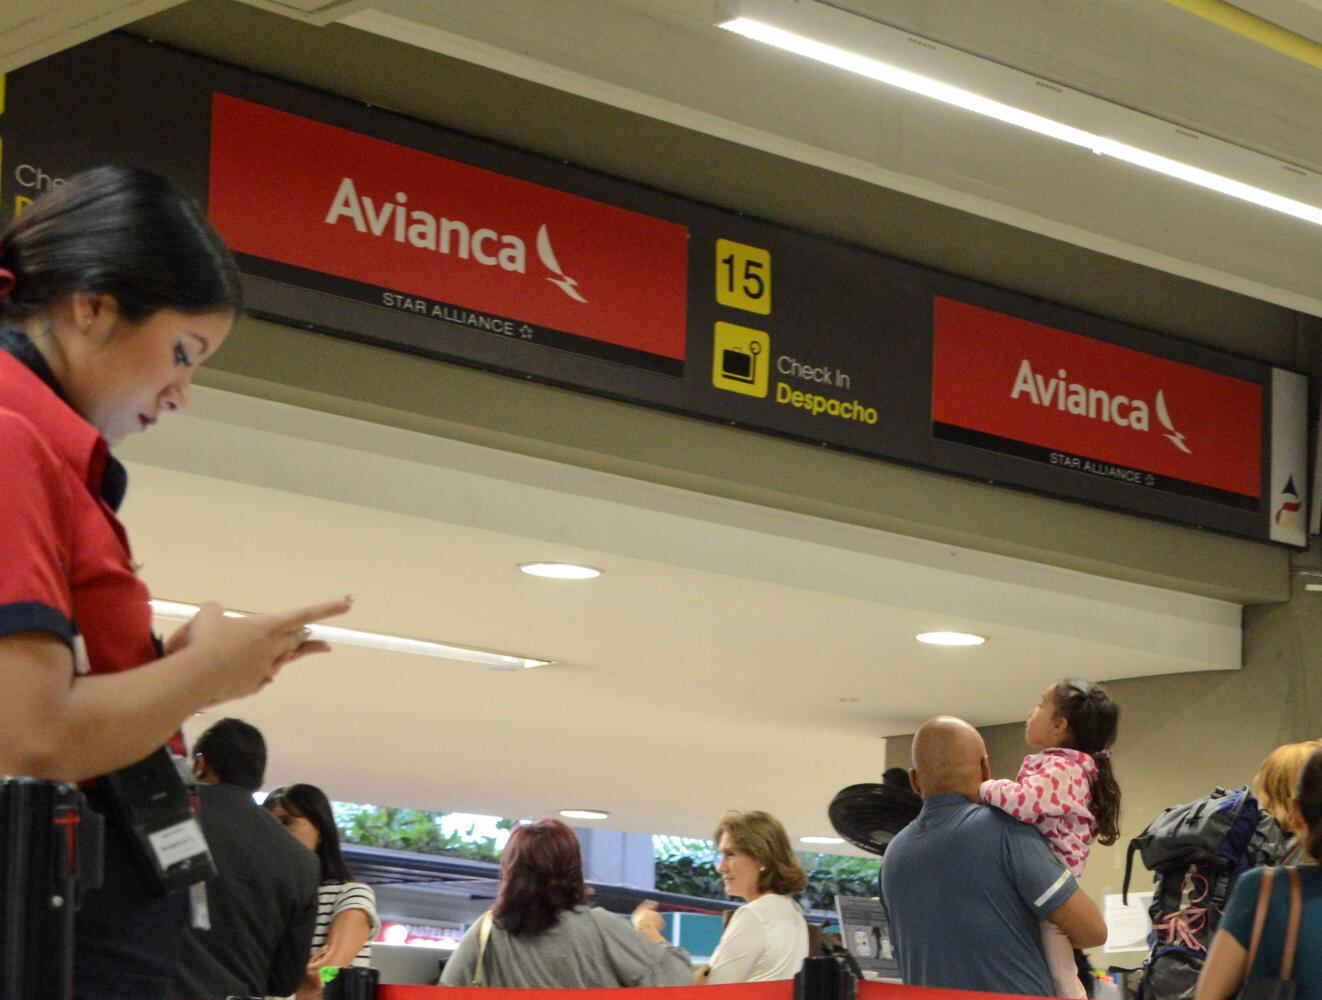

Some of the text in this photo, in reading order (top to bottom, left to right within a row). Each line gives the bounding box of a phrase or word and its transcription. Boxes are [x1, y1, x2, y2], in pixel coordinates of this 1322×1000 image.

[324, 177, 525, 274] Avianca
[722, 254, 764, 299] 15
[382, 293, 514, 336] STAR ALLIANCE
[777, 356, 850, 389] Check In
[776, 382, 878, 424] Despacho
[1011, 359, 1149, 432] Avianca
[1050, 452, 1142, 484] STAR ALLIANCE
